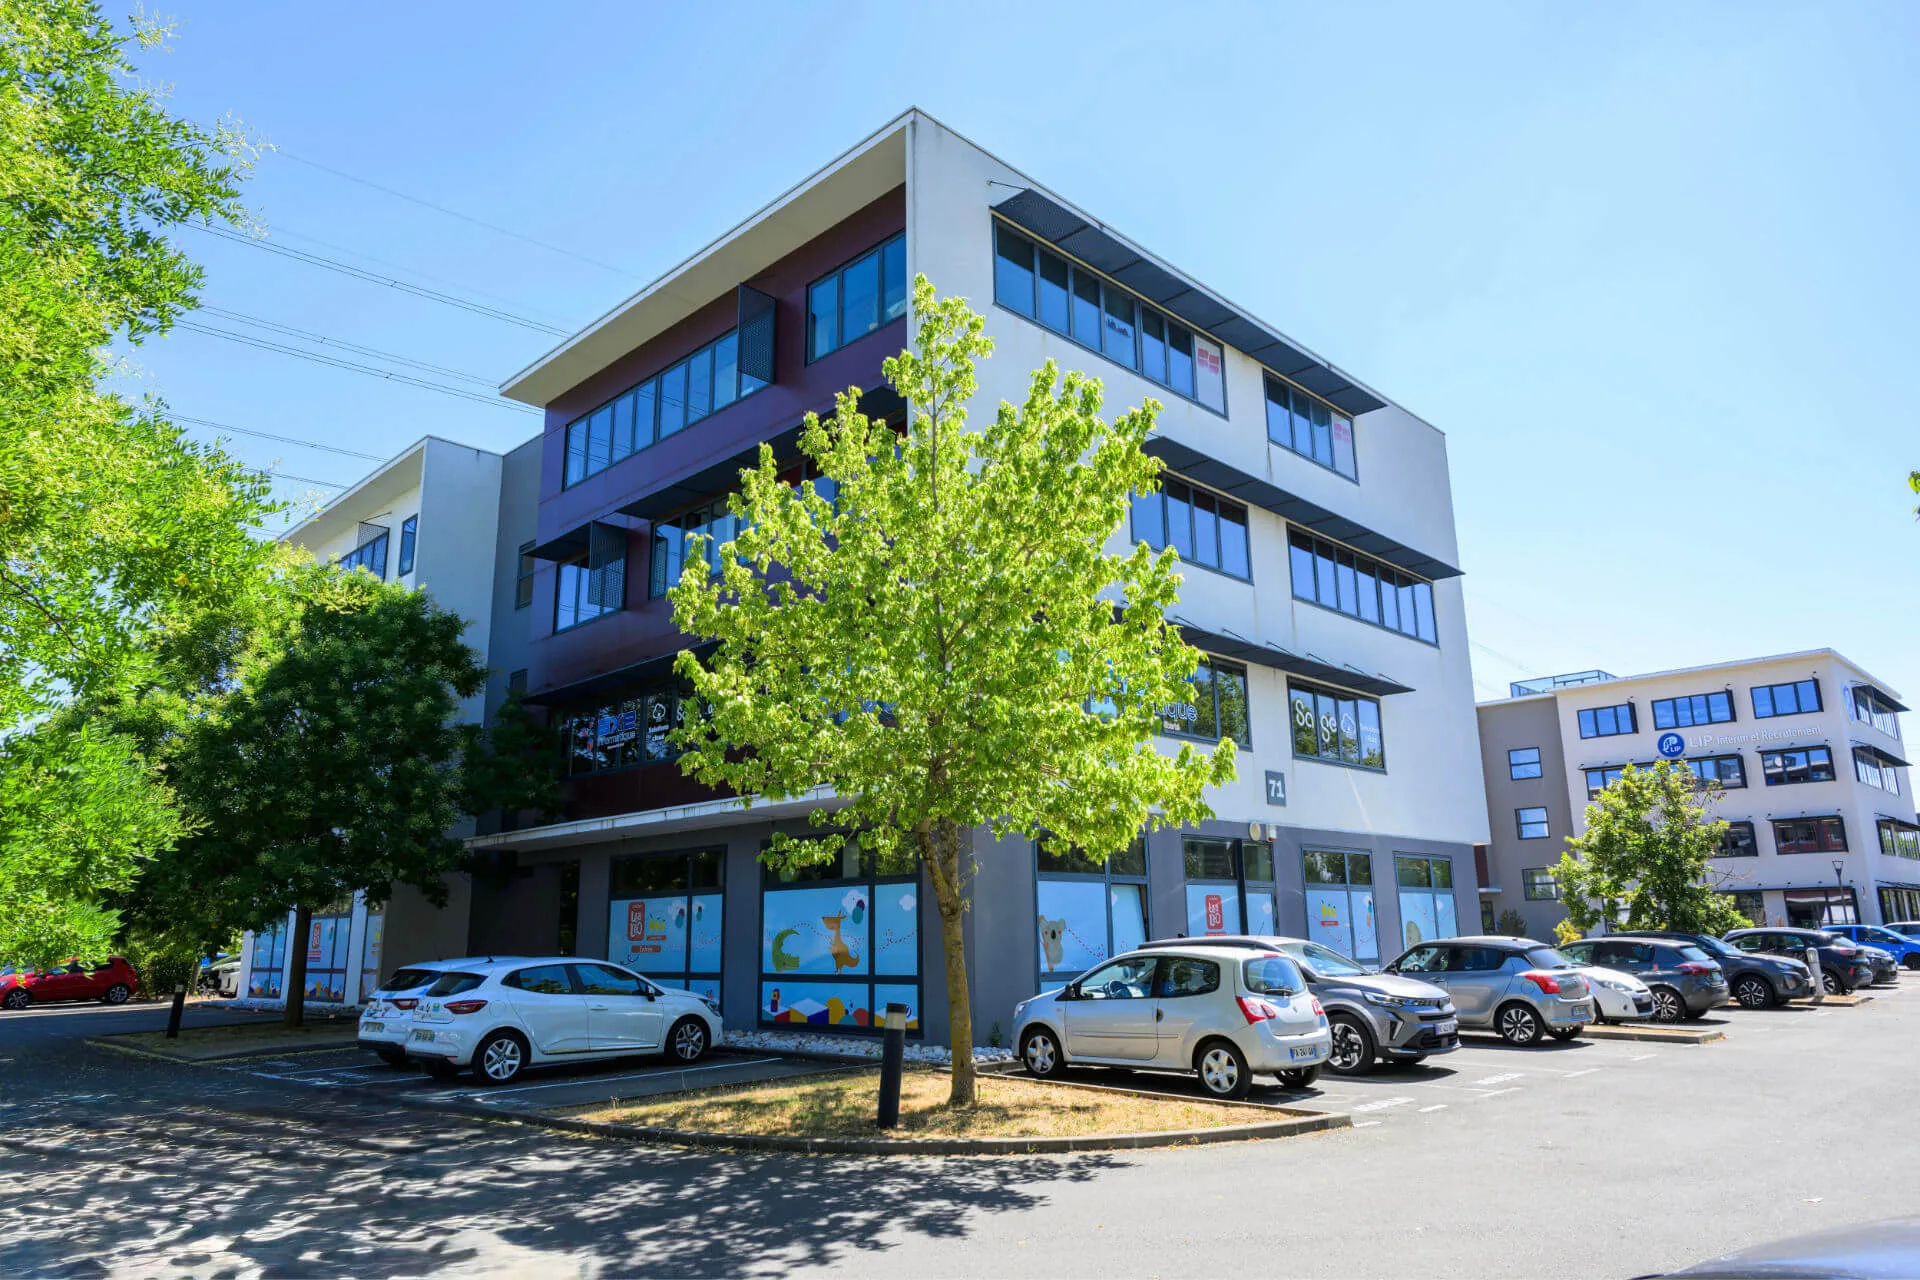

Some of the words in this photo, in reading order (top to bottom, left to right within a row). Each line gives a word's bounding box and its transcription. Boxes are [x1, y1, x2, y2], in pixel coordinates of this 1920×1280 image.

[1689, 735, 1714, 748] LIP
[1670, 745, 1681, 753] LIP
[1269, 779, 1284, 798] 71
